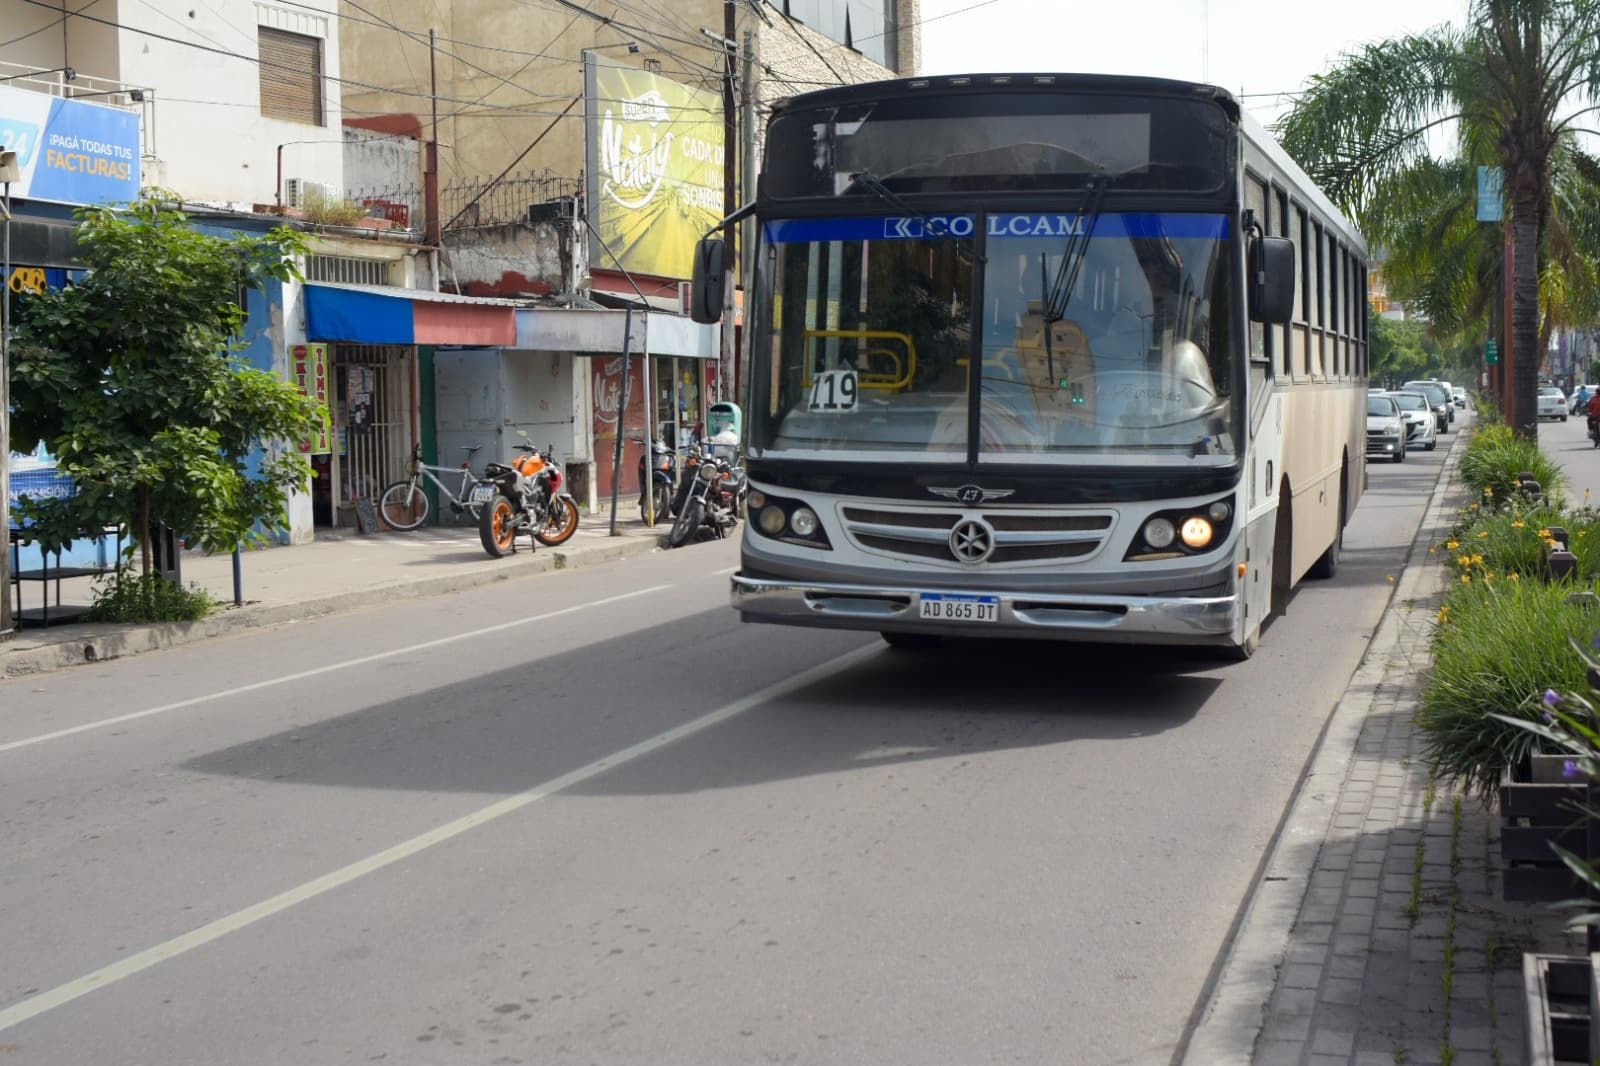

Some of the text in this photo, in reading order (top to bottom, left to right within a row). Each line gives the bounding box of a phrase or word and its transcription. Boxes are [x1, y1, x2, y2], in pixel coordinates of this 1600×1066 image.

[624, 97, 656, 117] SUPER
[81, 138, 112, 155] TODAS
[114, 145, 132, 159] TUS
[683, 136, 712, 161] CADA
[47, 149, 132, 181] FACTURAS!
[683, 184, 725, 210] SONRIS
[923, 602, 994, 620] AD 865 DT
